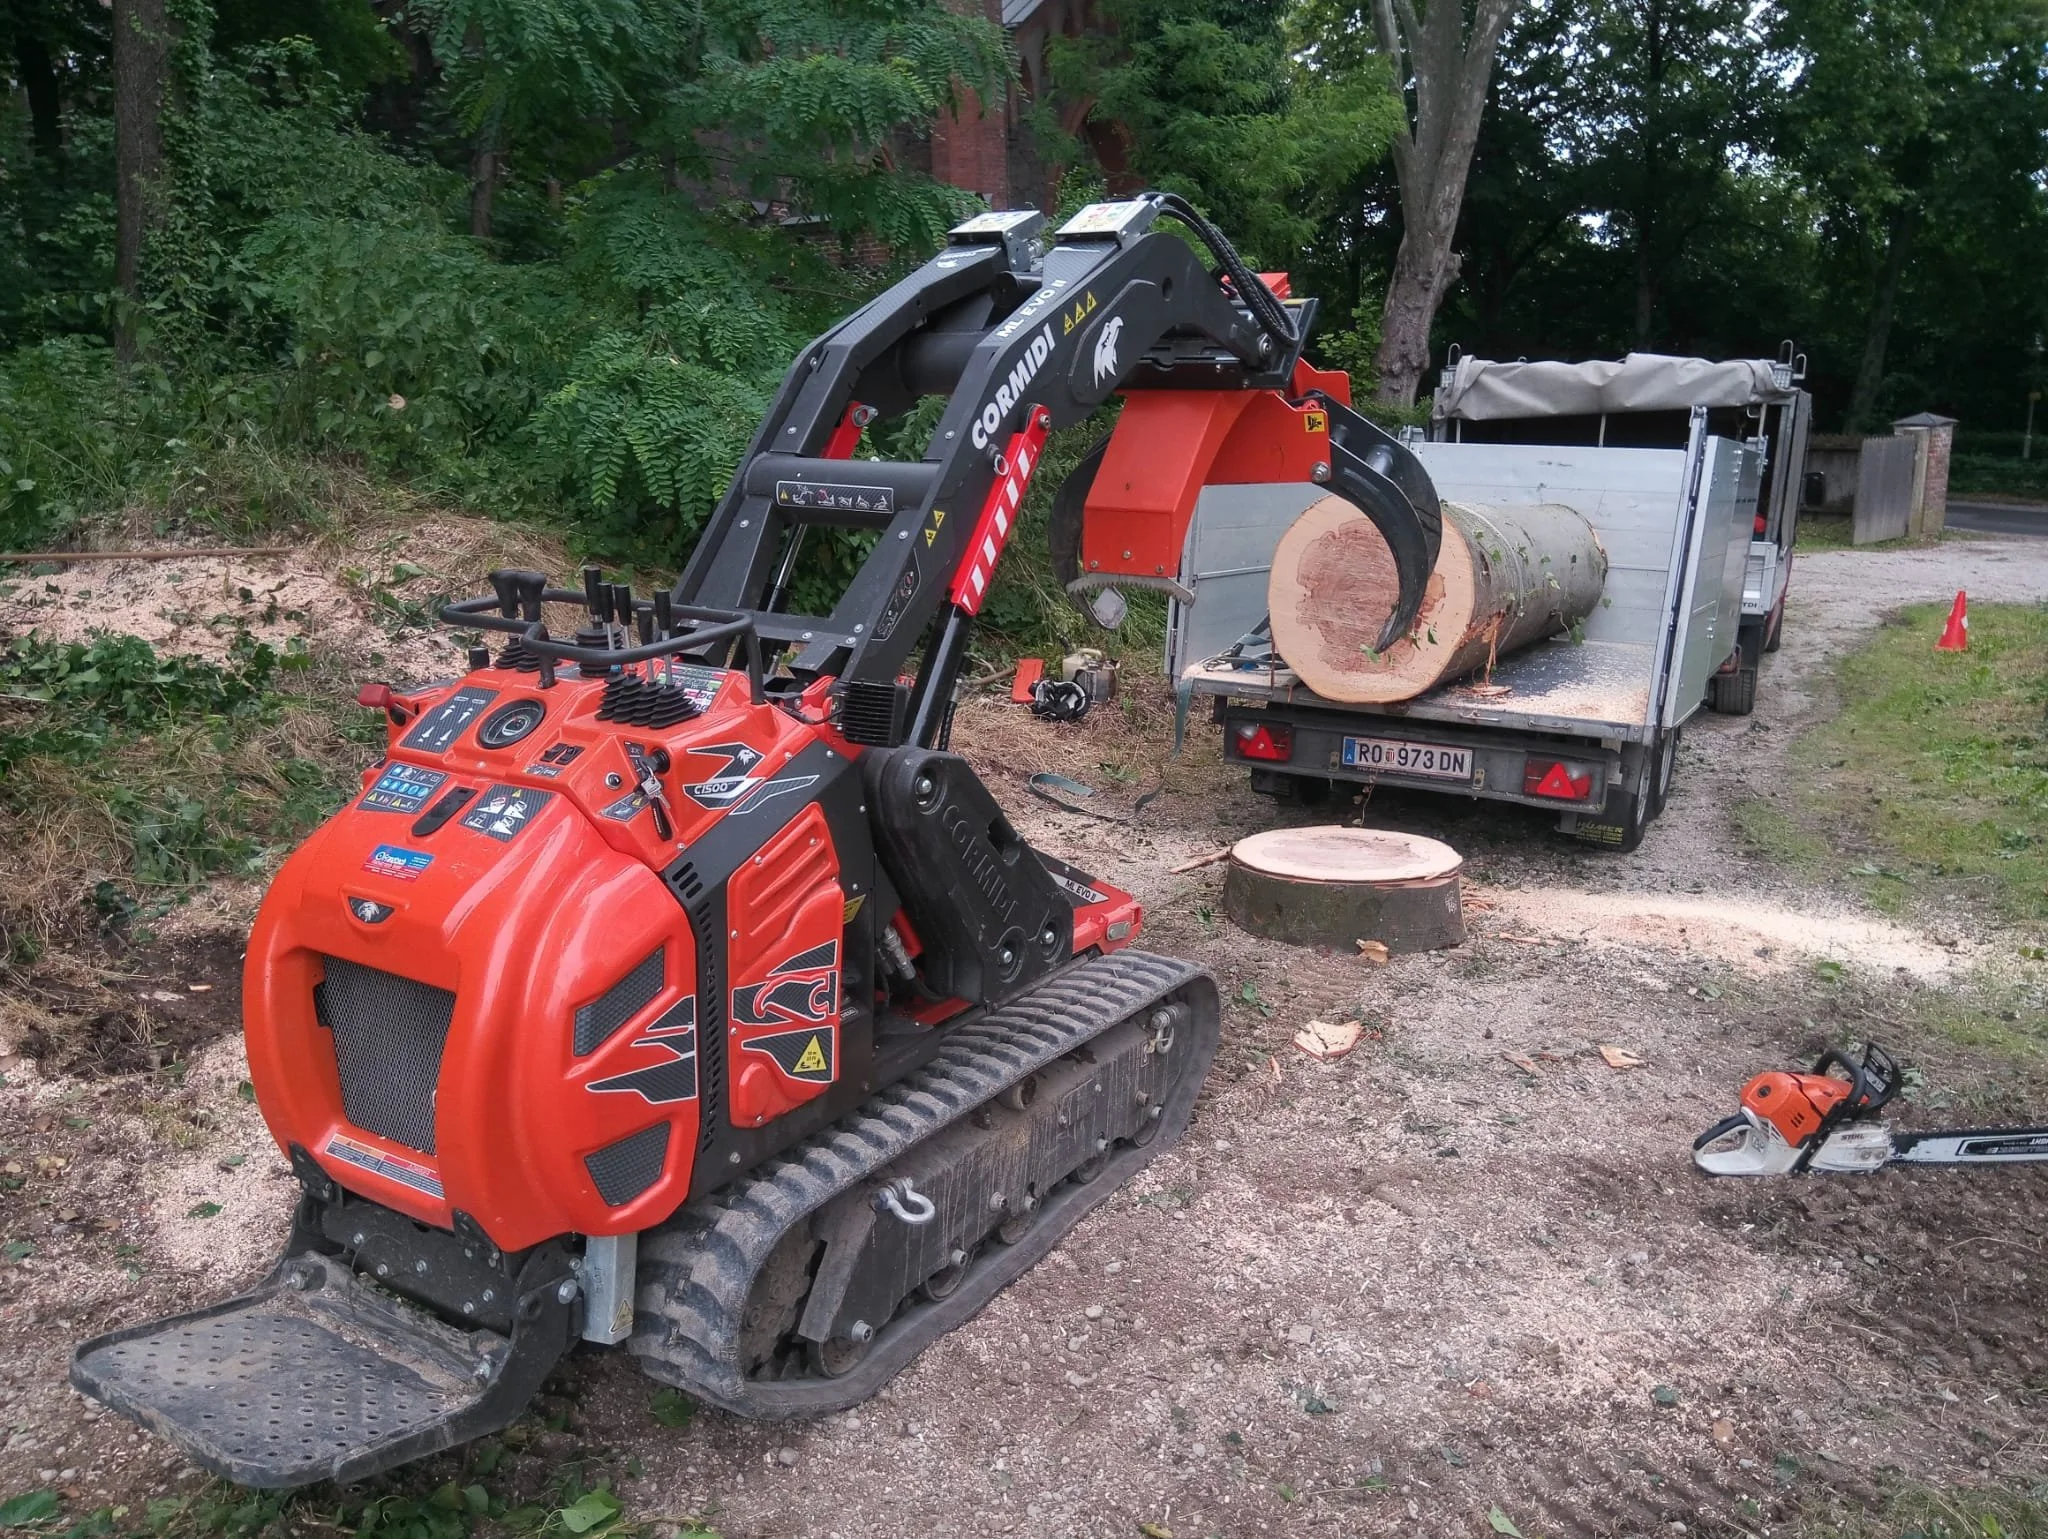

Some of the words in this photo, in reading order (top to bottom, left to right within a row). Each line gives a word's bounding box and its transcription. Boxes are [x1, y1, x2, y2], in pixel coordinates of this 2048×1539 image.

[996, 317, 1025, 339] ML
[1024, 288, 1056, 317] EVO
[1050, 279, 1068, 289] II
[971, 322, 1056, 450] CORMIDI
[1358, 743, 1382, 763] RO
[1397, 748, 1434, 770] 973
[1439, 751, 1465, 773] DN
[1065, 880, 1076, 891] ML
[1076, 884, 1092, 899] EVO
